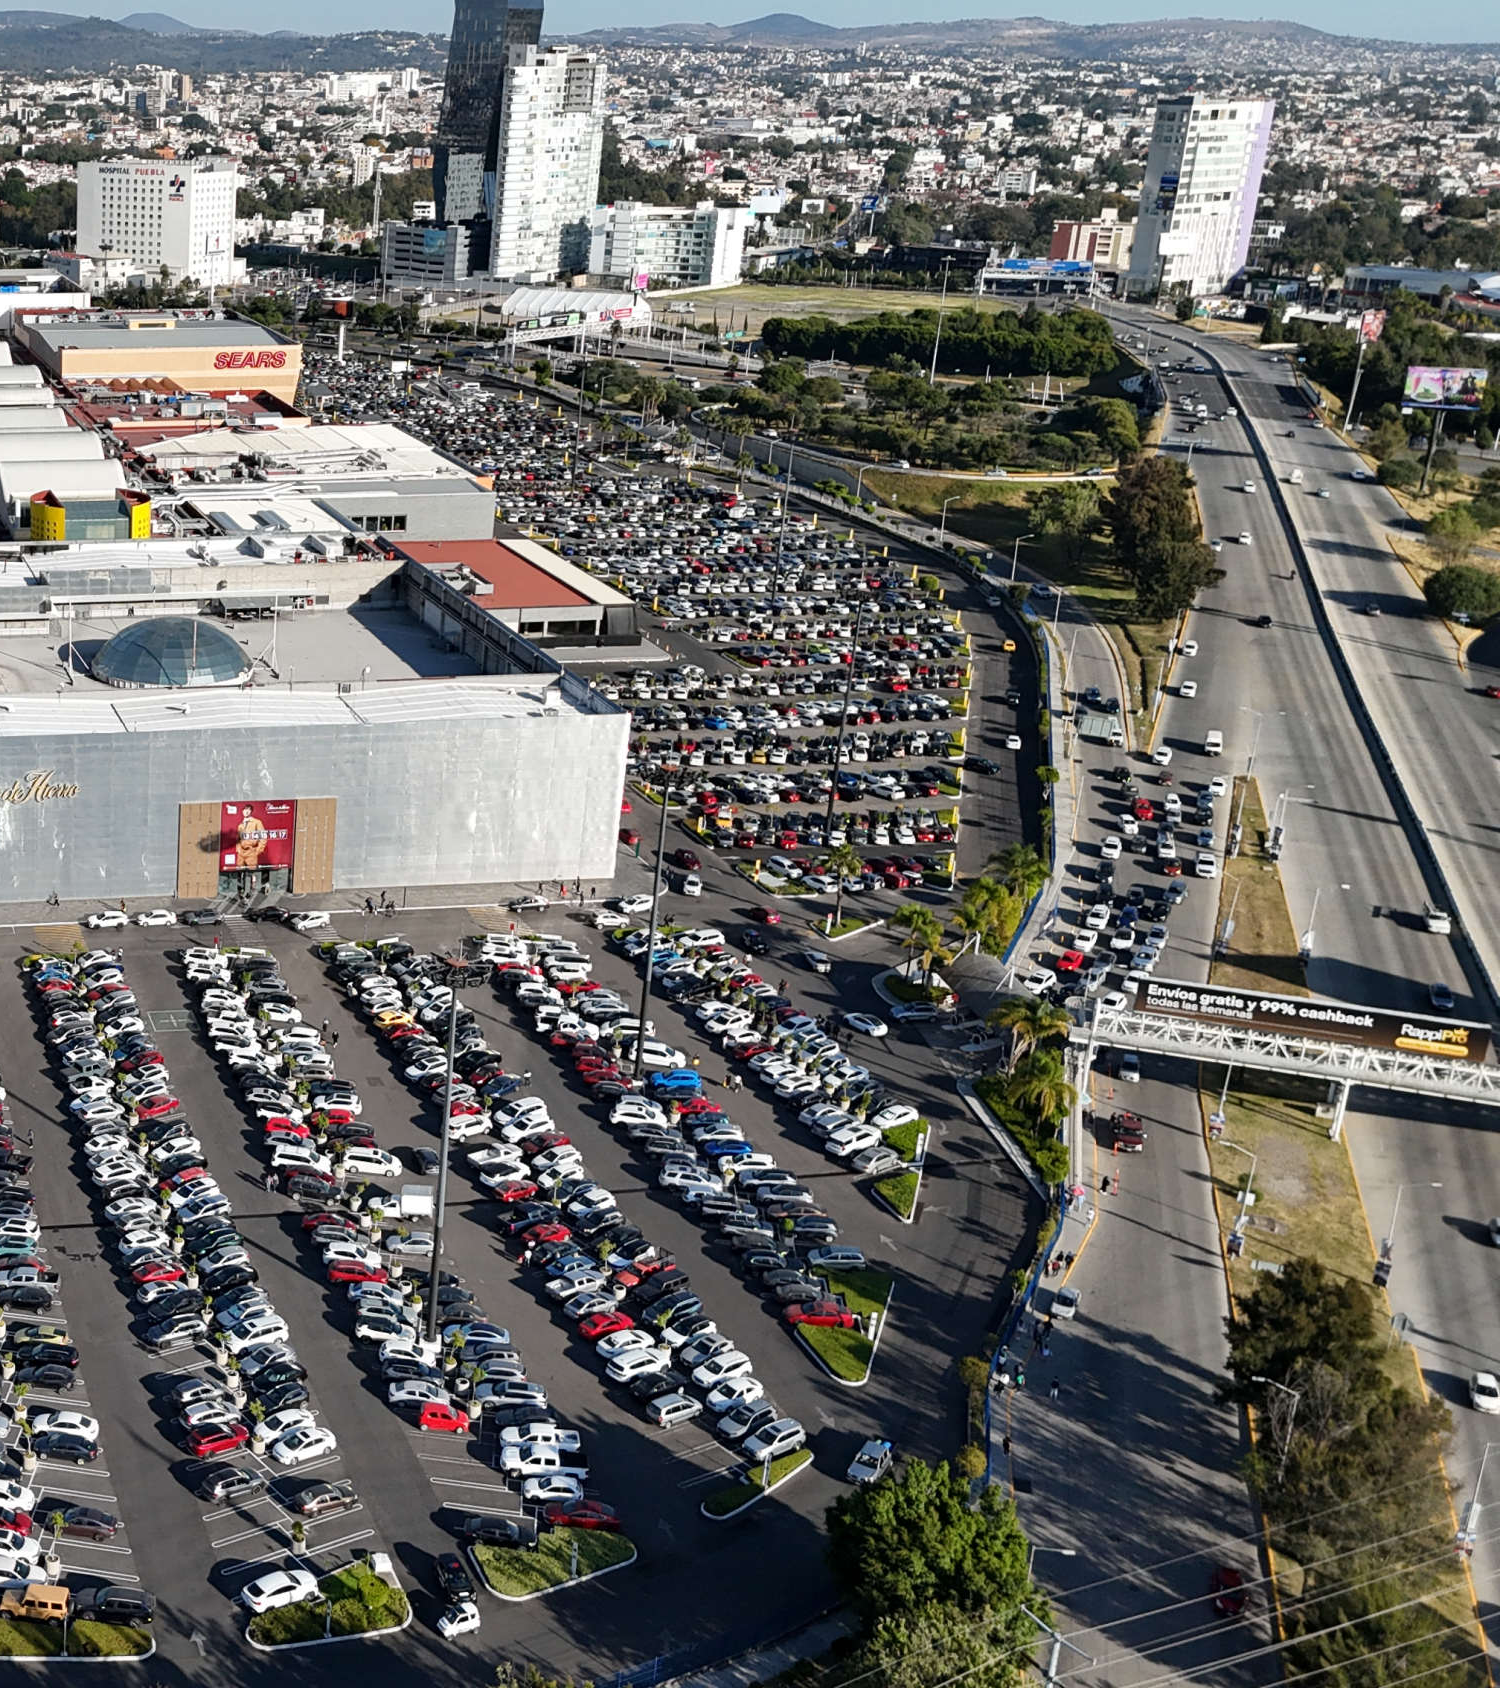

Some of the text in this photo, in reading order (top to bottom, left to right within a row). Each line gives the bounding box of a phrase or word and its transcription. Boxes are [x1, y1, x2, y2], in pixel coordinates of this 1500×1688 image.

[98, 167, 165, 176] HOSPITAL PUEBLA
[213, 351, 287, 370] SEARS
[1146, 996, 1253, 1019] todas las semanas
[1147, 983, 1198, 1001] Envíos
[1199, 993, 1245, 1009] gratis
[1246, 1000, 1257, 1012] y
[1259, 999, 1297, 1016] 99%
[1298, 1007, 1375, 1028] cashback
[1400, 1023, 1468, 1043] RappiPro
